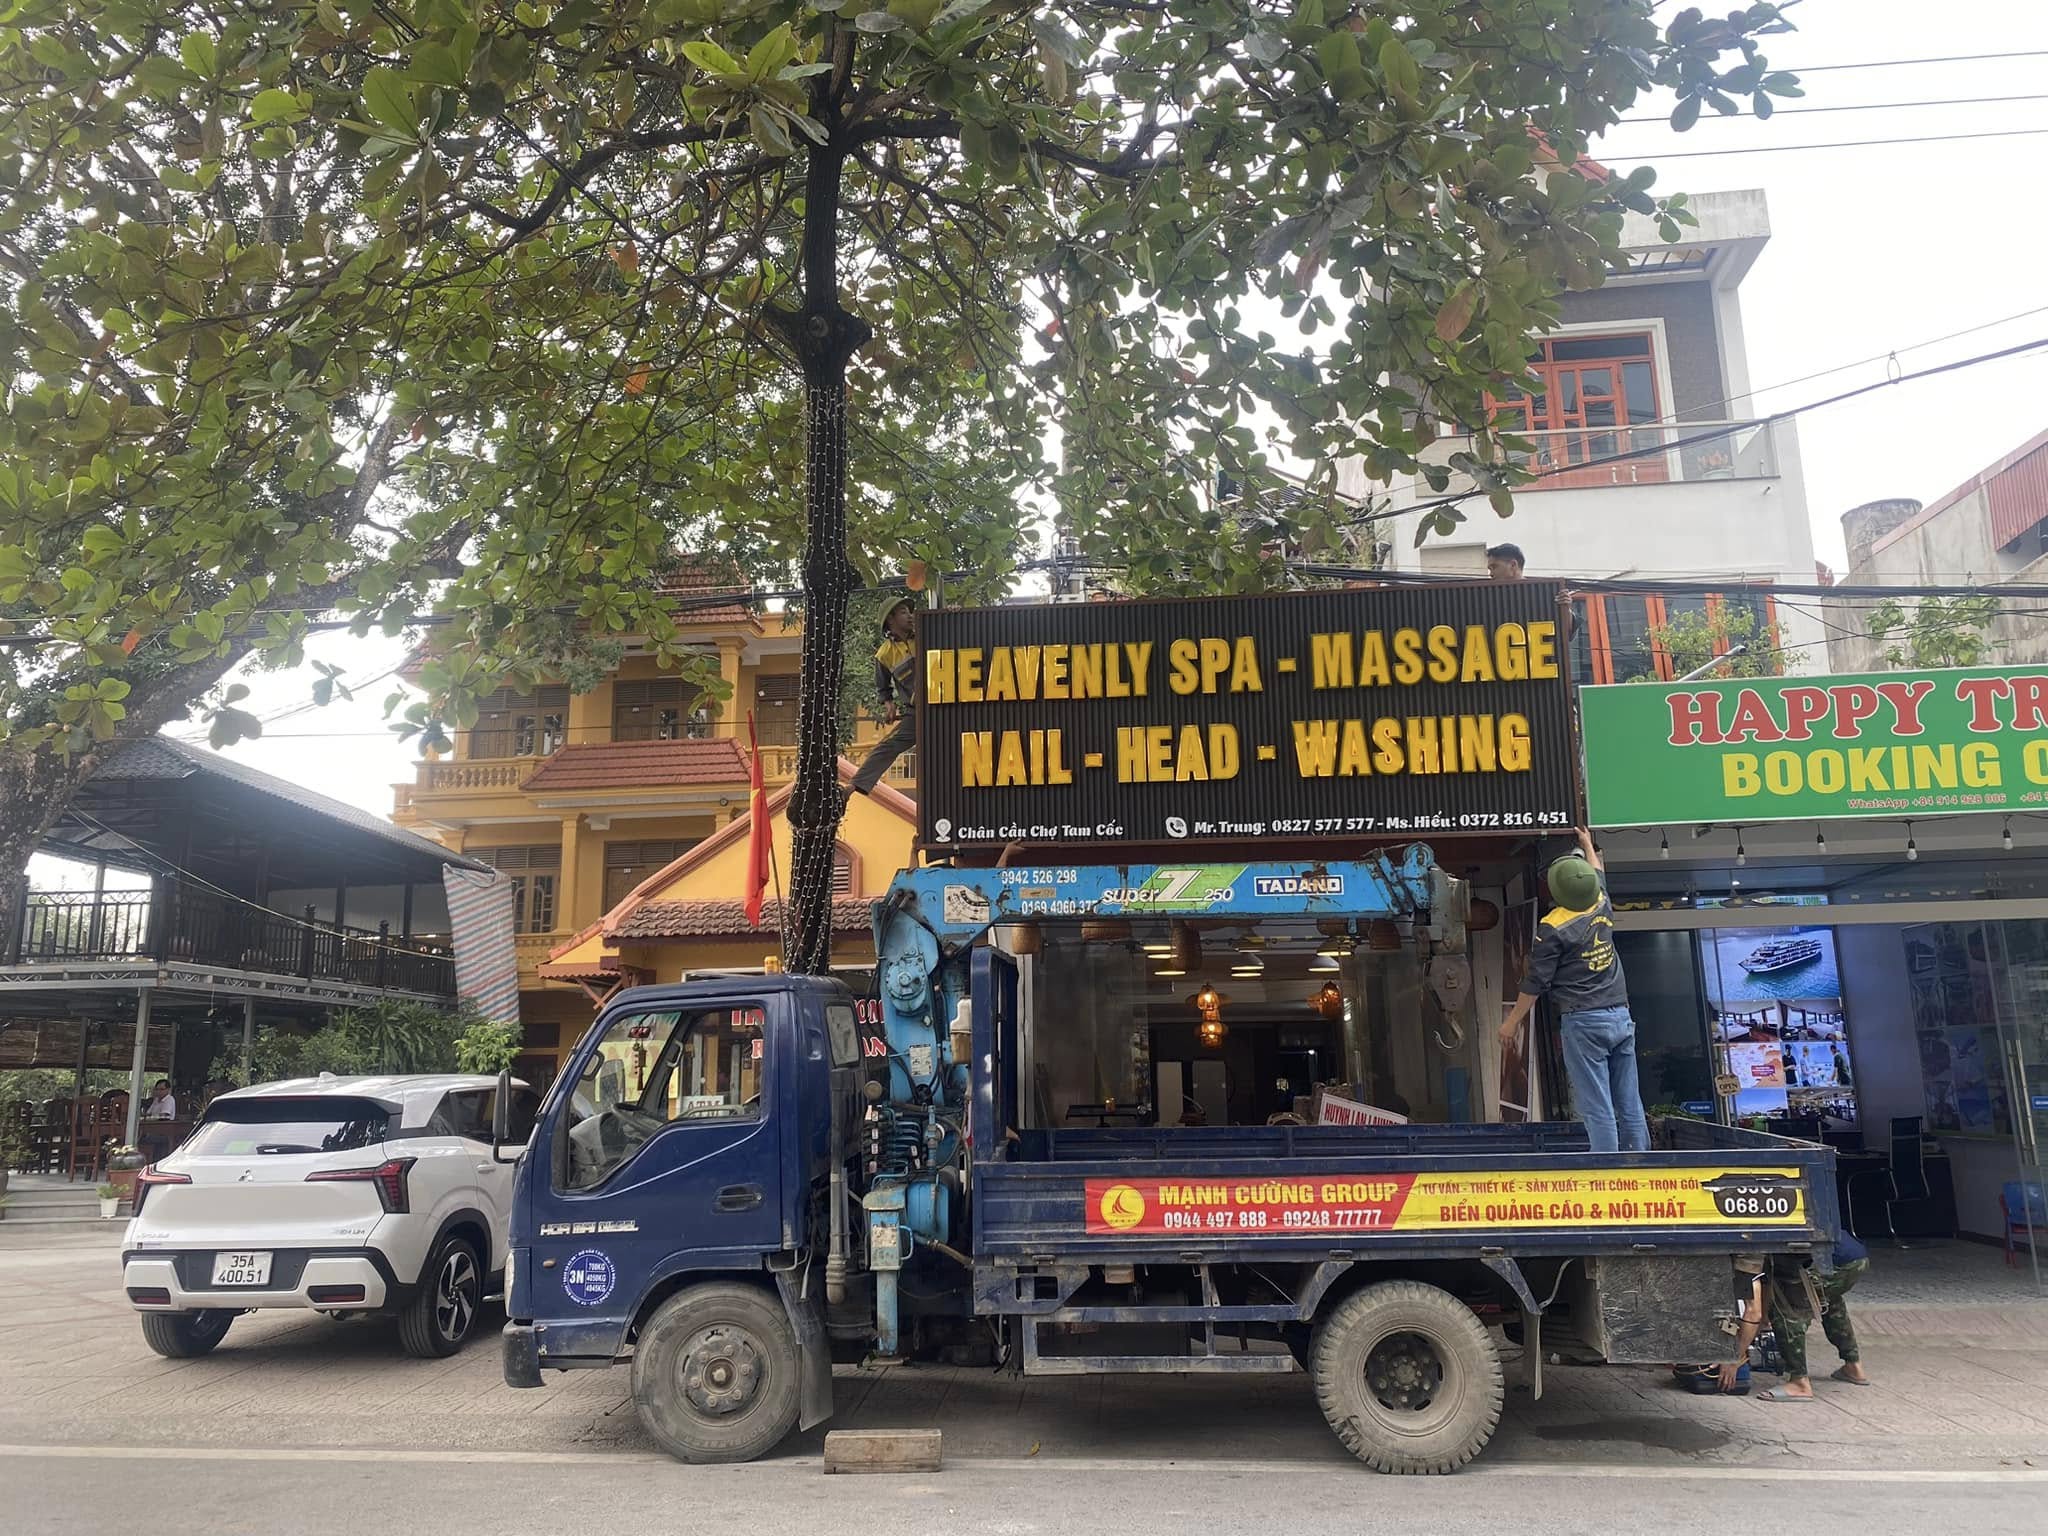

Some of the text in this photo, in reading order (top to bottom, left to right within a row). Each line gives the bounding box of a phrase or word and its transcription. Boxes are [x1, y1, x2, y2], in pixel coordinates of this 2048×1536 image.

[927, 621, 1558, 704] HEAVENLY SPA - MASSAGE
[1665, 675, 2048, 746] HAPPY TR
[961, 713, 1531, 787] NAIL - HEAD - WASHING
[1722, 742, 2002, 797] BOOKING
[1847, 797, 1908, 809] WhatsApp
[1912, 796, 1933, 806] +84
[1936, 794, 1958, 805] 914
[958, 818, 1124, 840] Chân Cầu Chợ Tam Cốc
[1272, 819, 1311, 832] 0827
[1315, 818, 1343, 831] 577
[1346, 817, 1375, 830] 577
[1459, 813, 1499, 827] 0372
[1503, 812, 1533, 826] 816
[1537, 811, 1568, 825] 451
[1032, 870, 1053, 884] 526
[1056, 869, 1077, 883] 298
[1257, 878, 1341, 893] TADANO
[1102, 887, 1160, 906] super
[1204, 888, 1234, 901] 250
[1590, 1180, 1606, 1192] THI
[1649, 1180, 1677, 1192] TRỌN
[1681, 1177, 1699, 1190] GÓI
[1159, 1181, 1398, 1209] MẠNH CƯỜNG GROUP
[1485, 1198, 1544, 1222] QUẢNG
[1590, 1203, 1603, 1219] &
[1609, 1199, 1638, 1222] NỘI
[1643, 1196, 1686, 1219] THẤT
[1724, 1197, 1788, 1214] 068.00
[1164, 1212, 1201, 1228] 0944
[1206, 1211, 1233, 1228] 497
[1239, 1211, 1267, 1227] 888
[1283, 1210, 1330, 1227] 09248
[1335, 1209, 1382, 1226] 77777
[230, 1255, 255, 1268] 35A
[218, 1269, 262, 1283] 400.51
[569, 1269, 585, 1284] 3N
